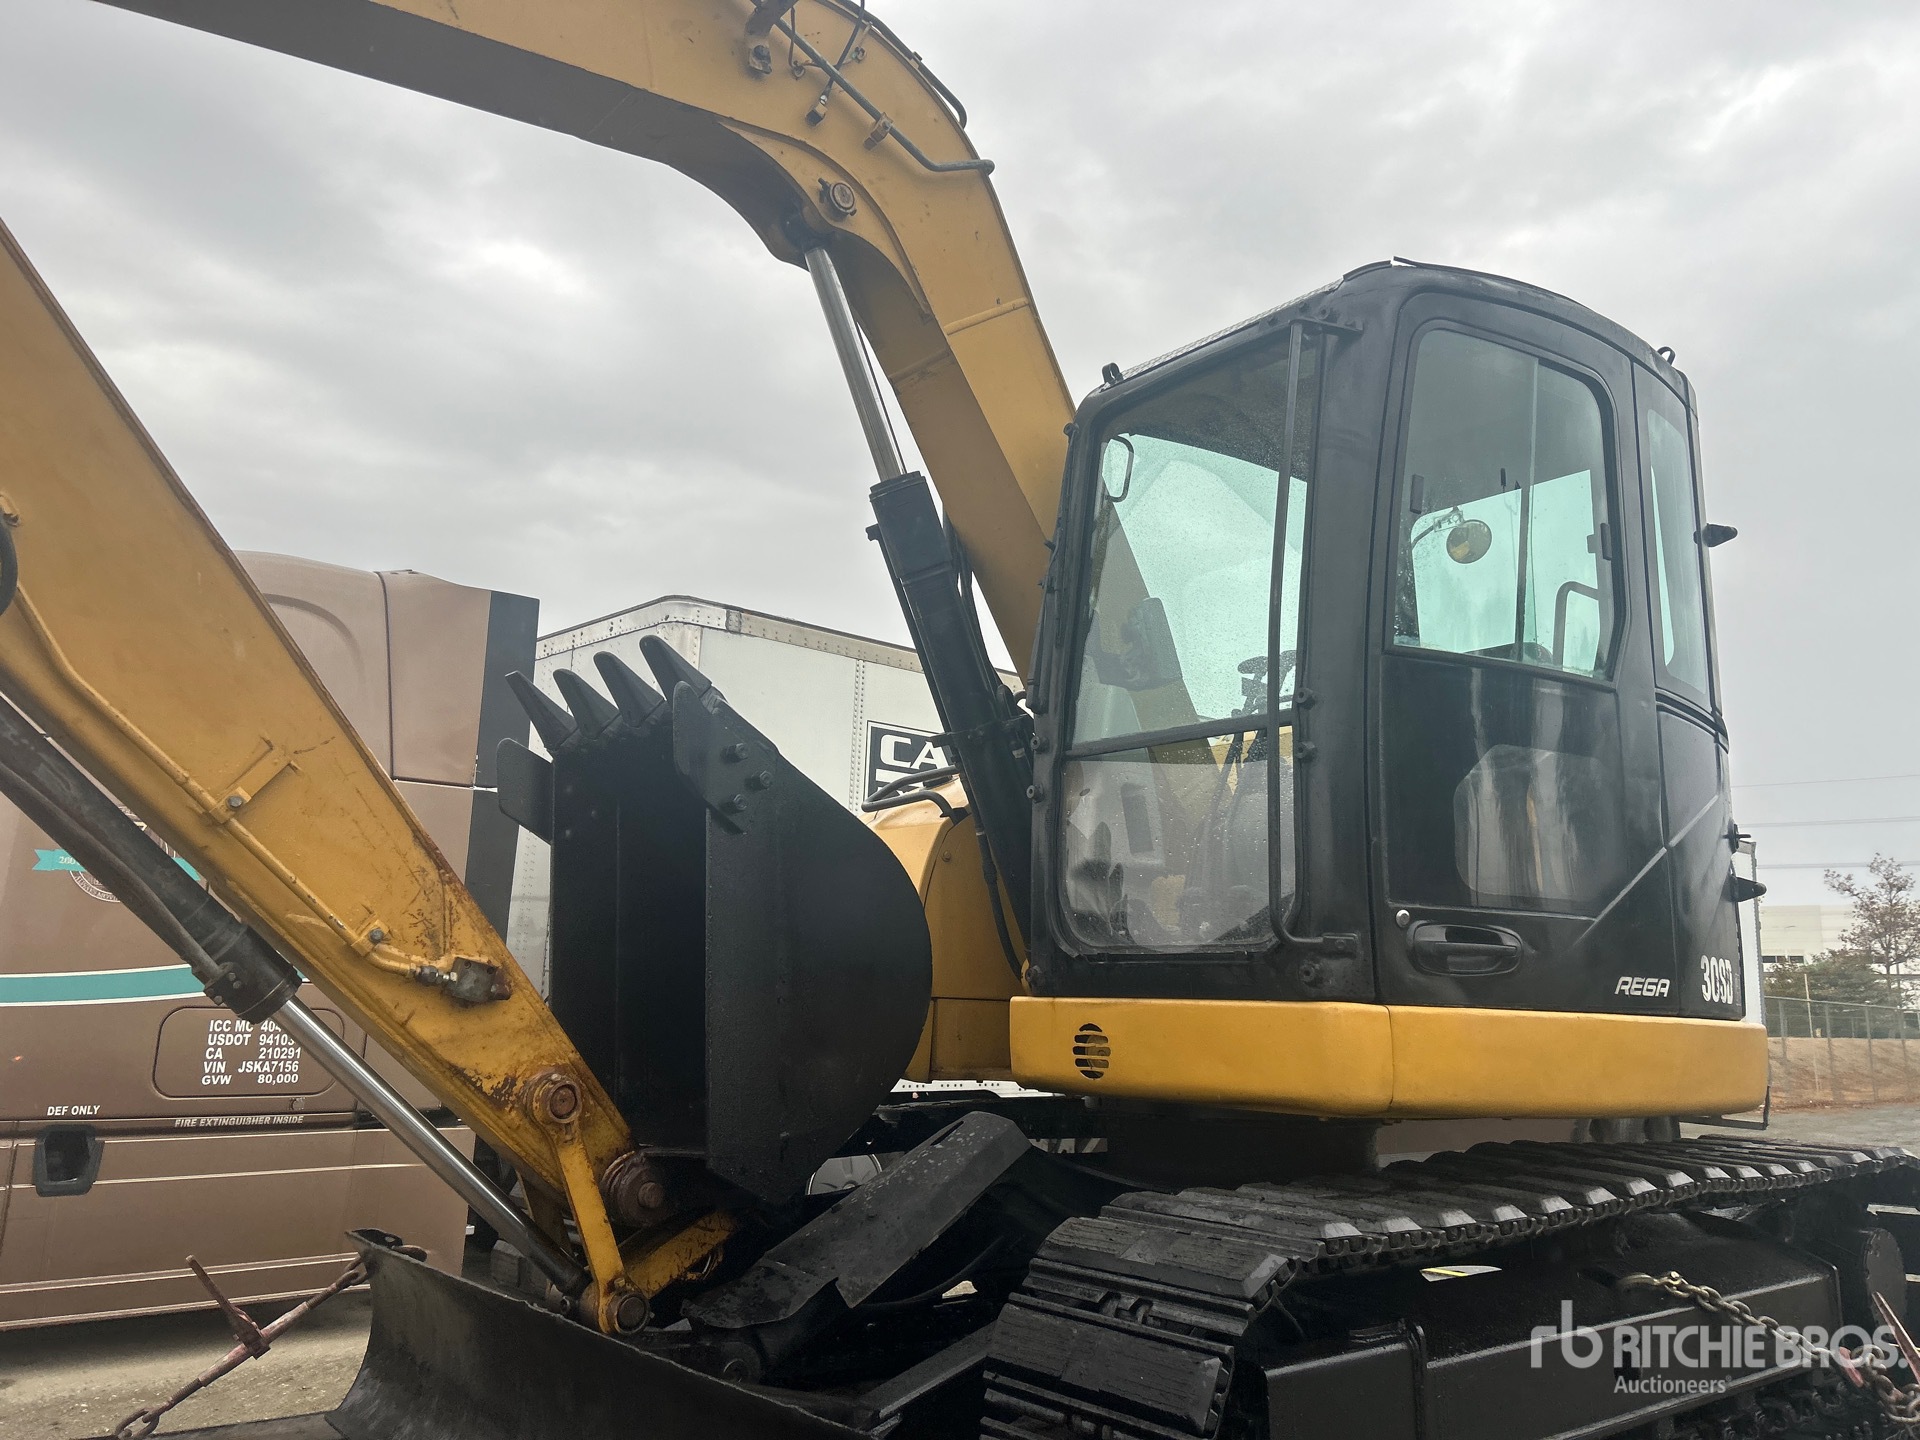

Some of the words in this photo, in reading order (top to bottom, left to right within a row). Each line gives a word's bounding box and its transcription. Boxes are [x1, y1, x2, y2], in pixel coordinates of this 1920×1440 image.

[1614, 976, 1671, 998] REGA
[209, 1020, 232, 1032] ICC
[235, 1020, 254, 1032] MC
[207, 1033, 252, 1046] USDOT
[205, 1047, 223, 1059] CA
[258, 1047, 301, 1059] 210291
[203, 1061, 227, 1074] VIN
[237, 1060, 300, 1073] JSKA7156
[201, 1074, 232, 1085] GVW
[257, 1073, 299, 1085] 80,000
[47, 1106, 69, 1116] DEF
[71, 1105, 101, 1115] ONLY
[174, 1118, 197, 1128] FIRE
[199, 1116, 271, 1127] EXTINGUISHER
[272, 1115, 304, 1125] INSIDE
